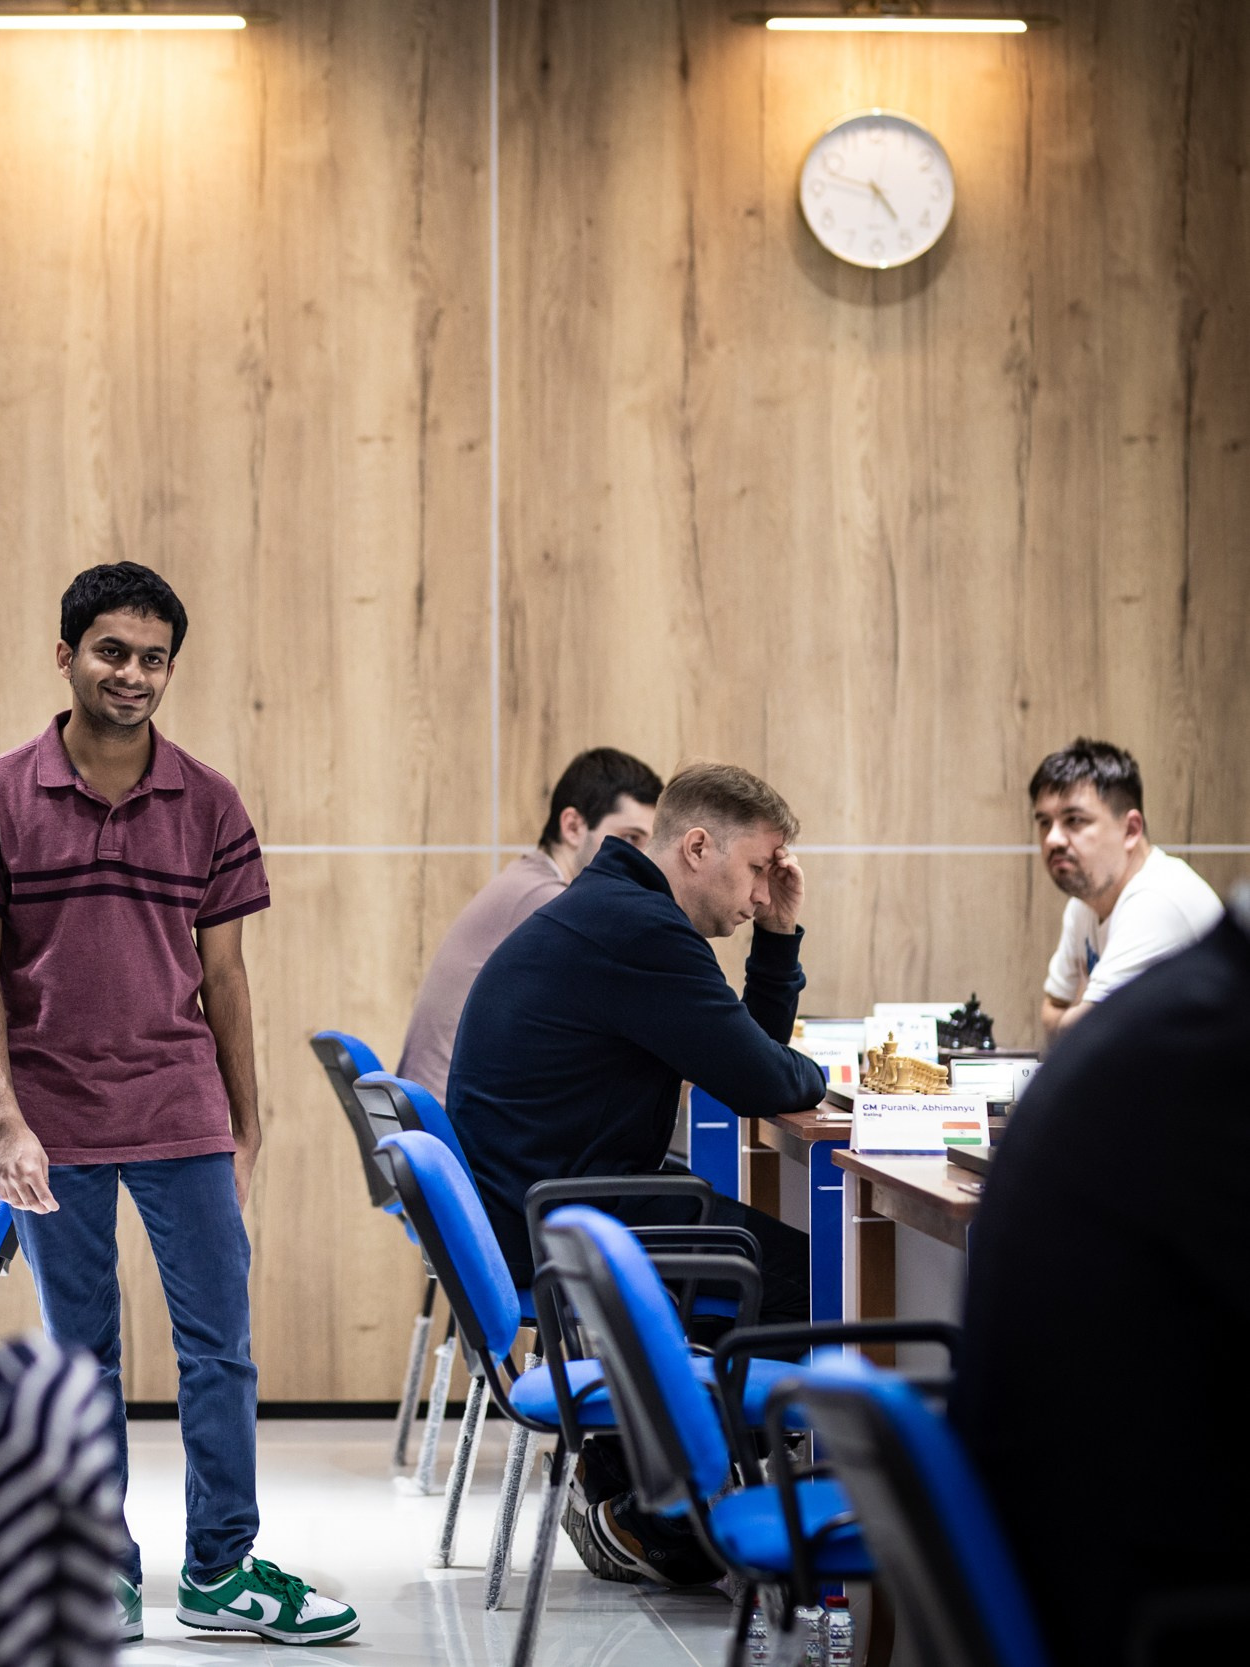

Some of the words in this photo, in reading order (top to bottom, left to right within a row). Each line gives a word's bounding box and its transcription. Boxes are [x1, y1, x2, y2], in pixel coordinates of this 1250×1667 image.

[917, 207, 932, 228] 4
[844, 228, 857, 247] 7
[913, 1040, 930, 1051] 21
[862, 1103, 878, 1111] GM
[881, 1103, 920, 1112] Puranik,
[922, 1103, 975, 1113] Abhimanyu
